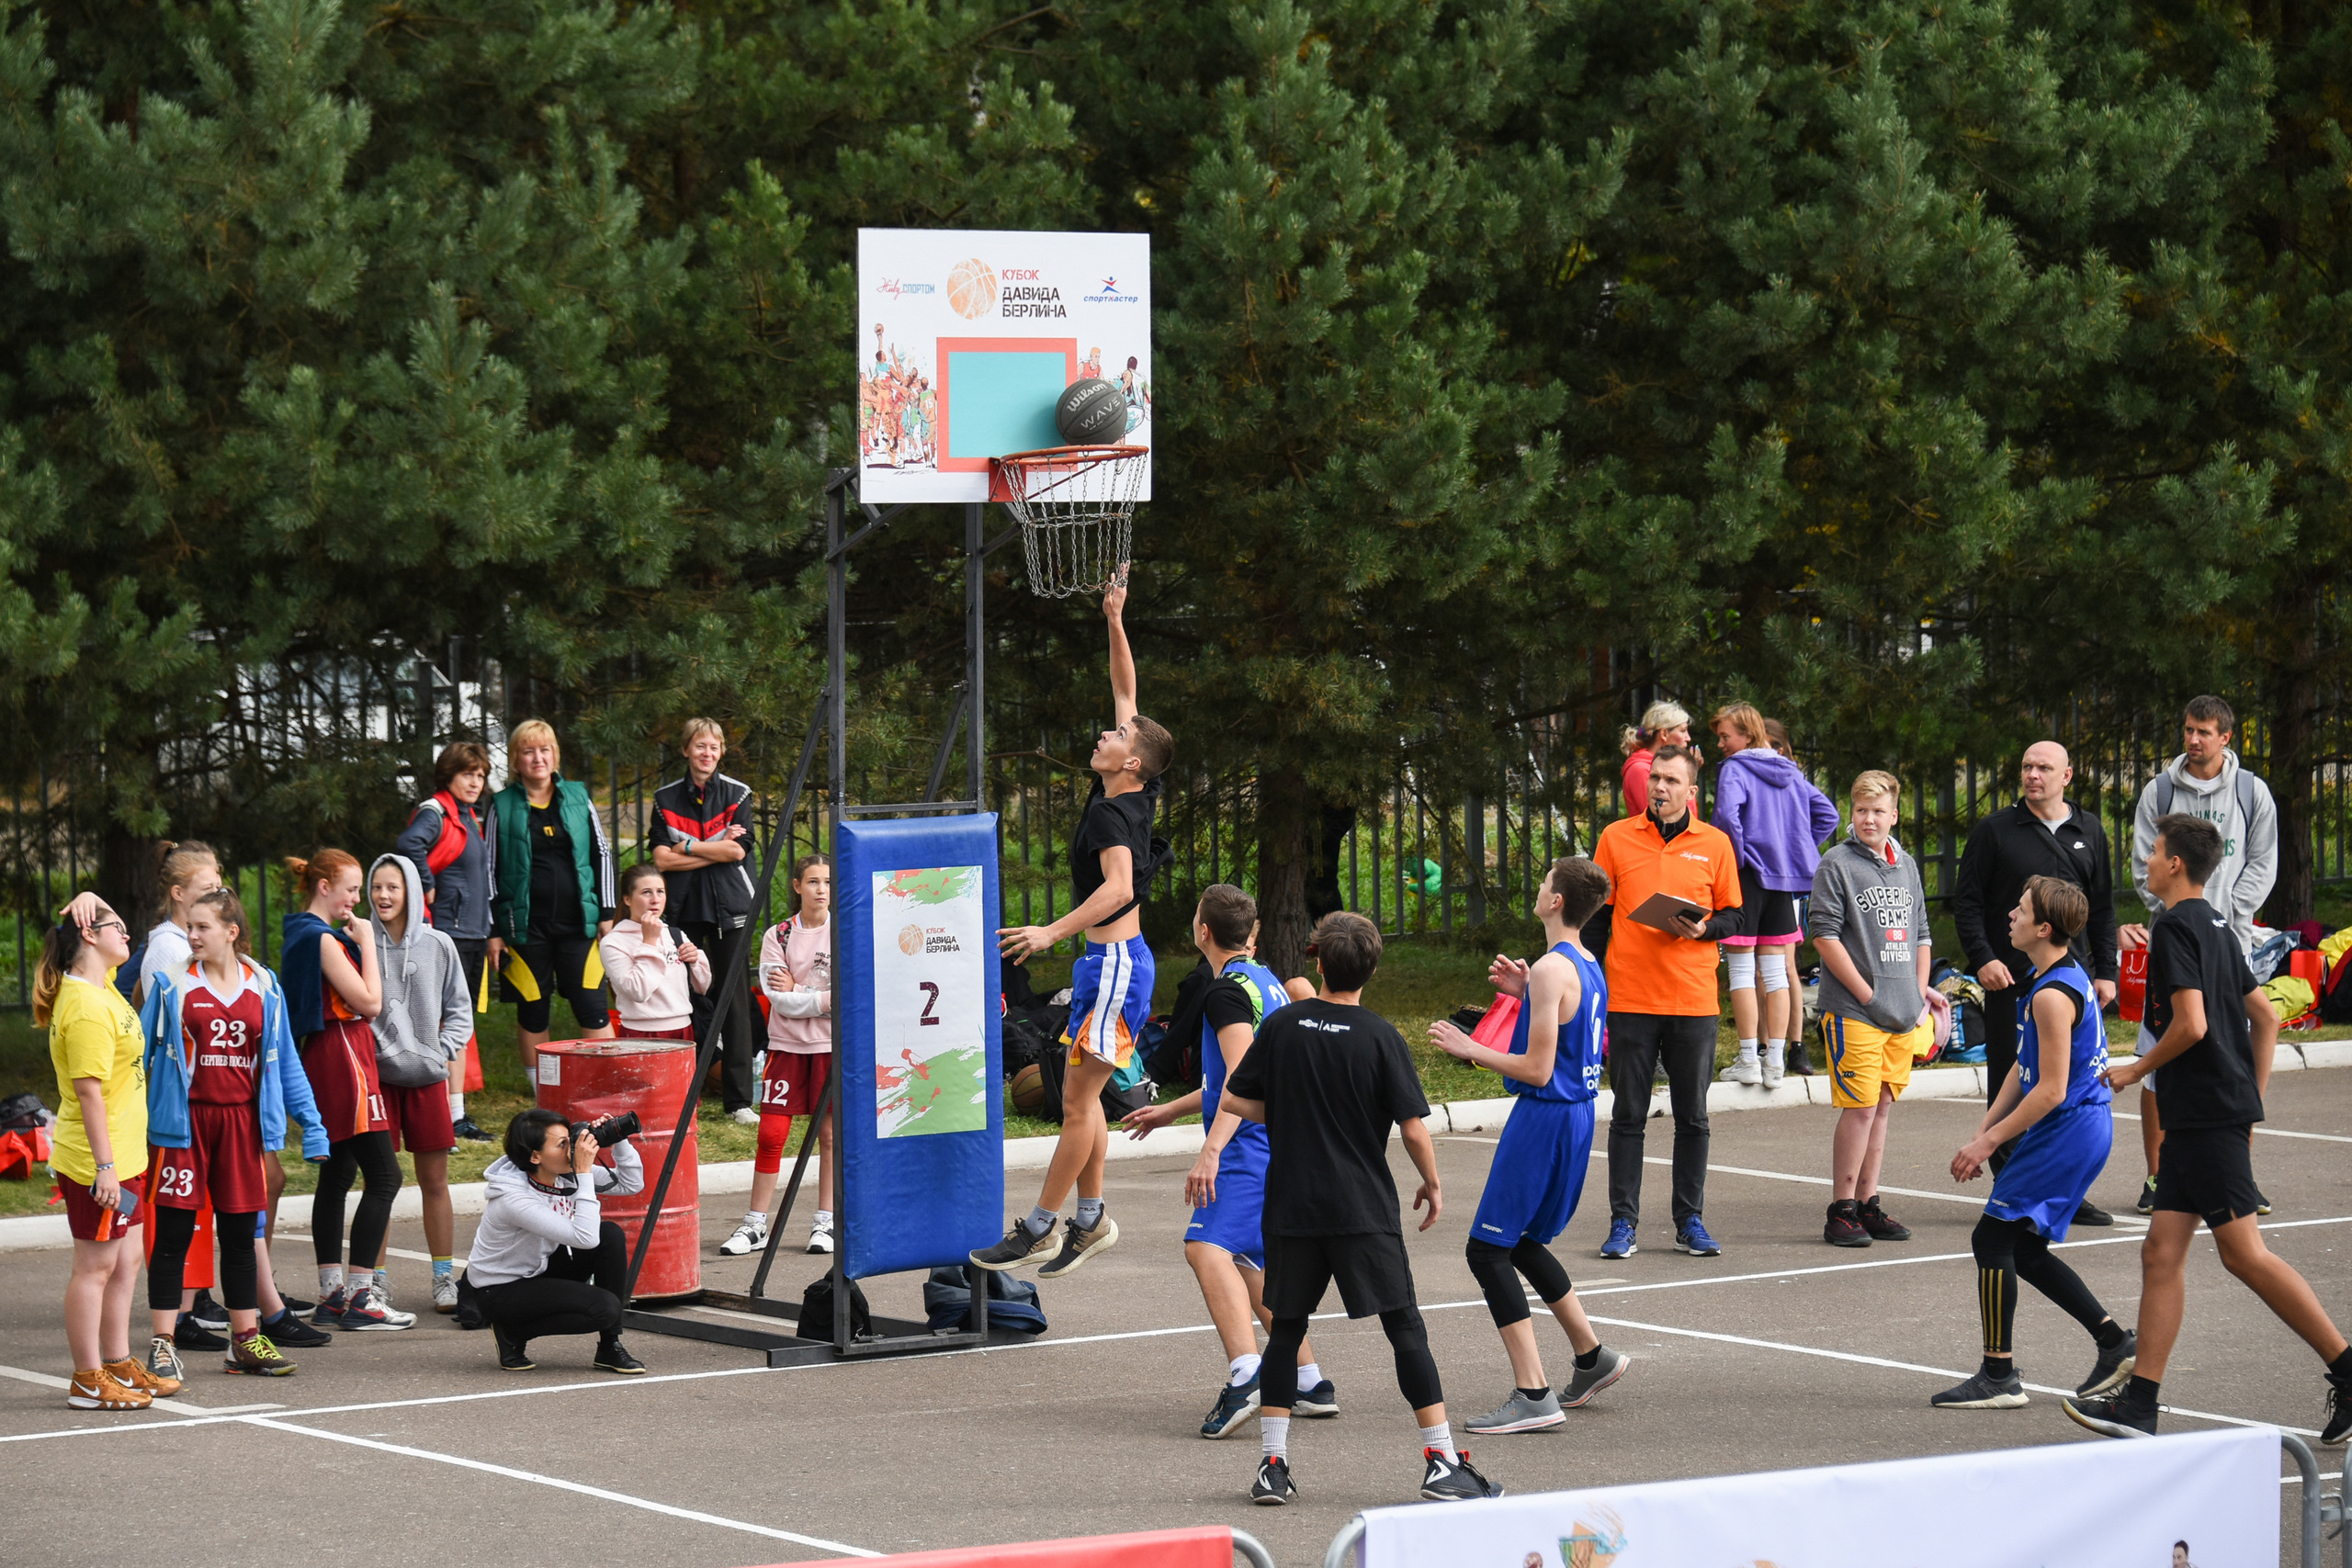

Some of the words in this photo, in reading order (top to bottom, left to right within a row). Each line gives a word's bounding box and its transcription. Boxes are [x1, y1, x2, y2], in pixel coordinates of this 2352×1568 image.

[1002, 269, 1040, 280] КУБОК
[903, 284, 934, 294] СПОРТОМ
[1002, 287, 1060, 303] ДАВИДА
[1002, 304, 1067, 318] БЕРЛИНА
[1067, 383, 1108, 412] Wilson
[1080, 397, 1121, 428] WAVE
[926, 935, 956, 946] ДАВИДА
[926, 944, 960, 953] БЕРЛИНА
[920, 981, 940, 1026] 2
[209, 1018, 246, 1049] 23
[762, 1079, 790, 1107] 12
[158, 1166, 194, 1197] 23
